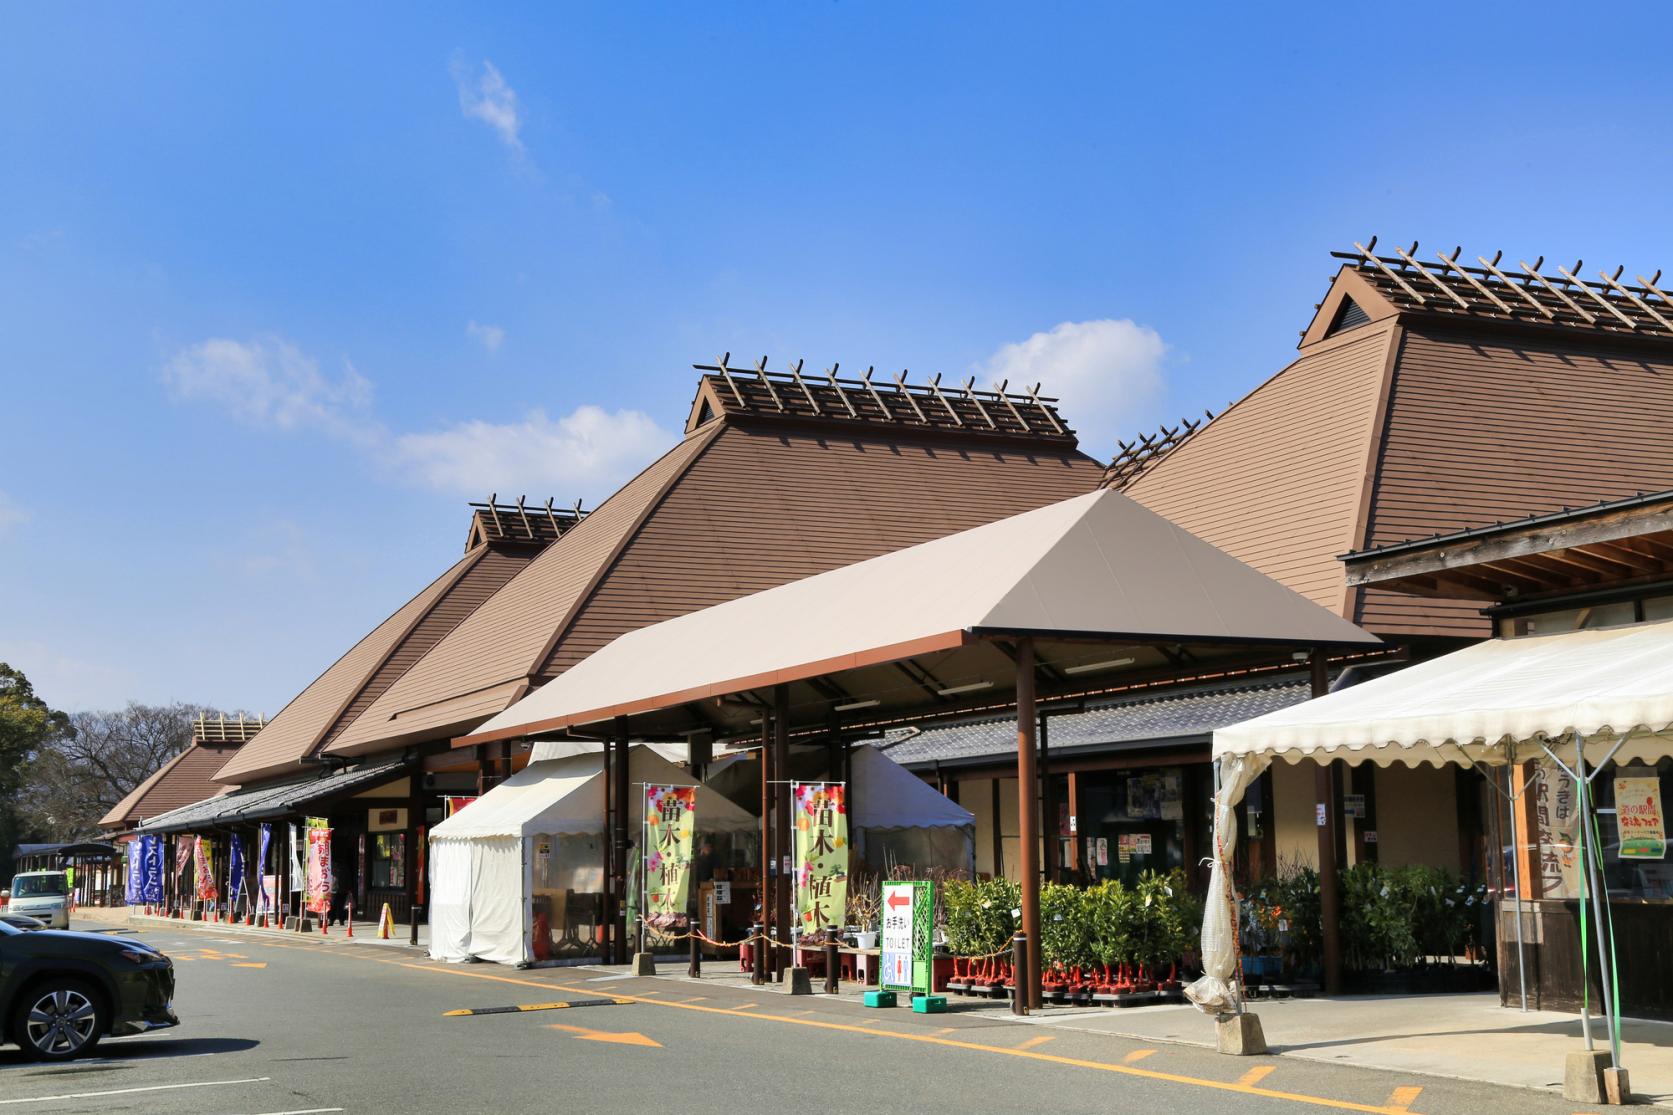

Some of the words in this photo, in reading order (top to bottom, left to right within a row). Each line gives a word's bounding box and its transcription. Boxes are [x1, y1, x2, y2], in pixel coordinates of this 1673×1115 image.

[809, 799, 834, 928] 苗木・植木
[886, 916, 910, 930] お手洗い
[886, 937, 910, 949] TOILET
